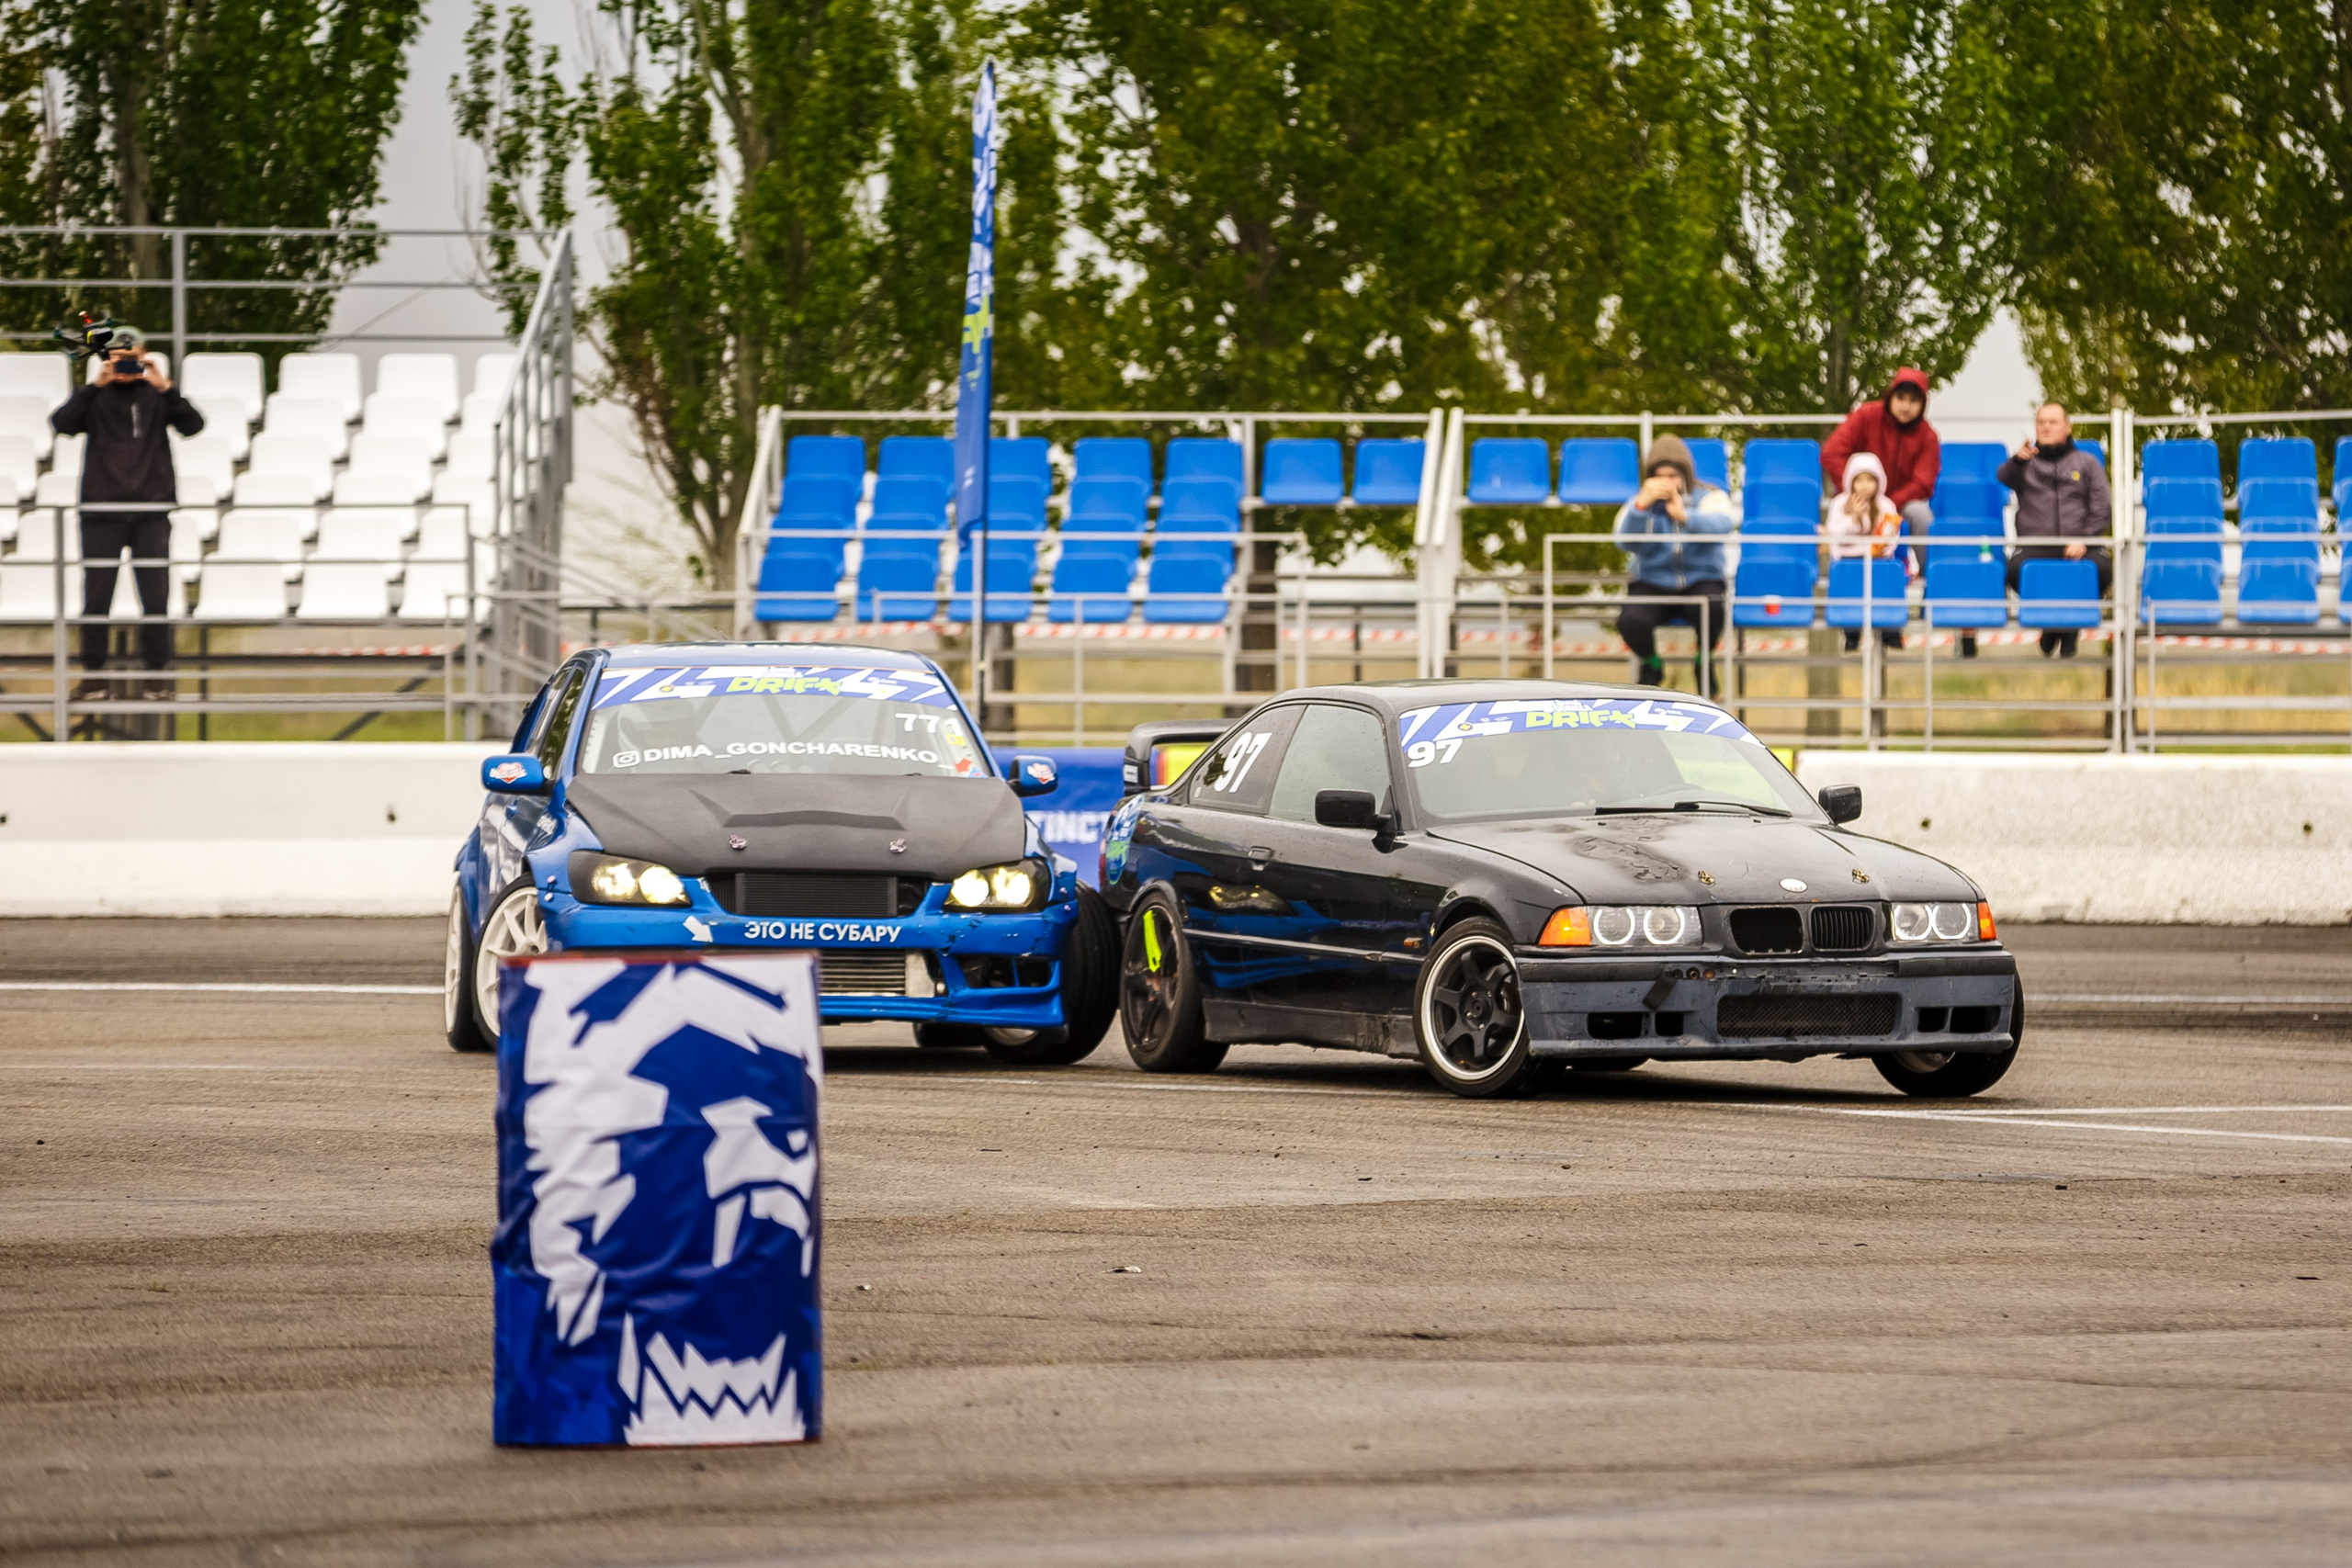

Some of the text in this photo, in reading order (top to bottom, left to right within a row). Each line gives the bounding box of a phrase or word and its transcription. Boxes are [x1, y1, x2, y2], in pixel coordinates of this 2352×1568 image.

[1214, 732, 1272, 793] 97
[1408, 739, 1463, 768] 97
[744, 921, 902, 942] ЭТО НЕ СУБАРУ
